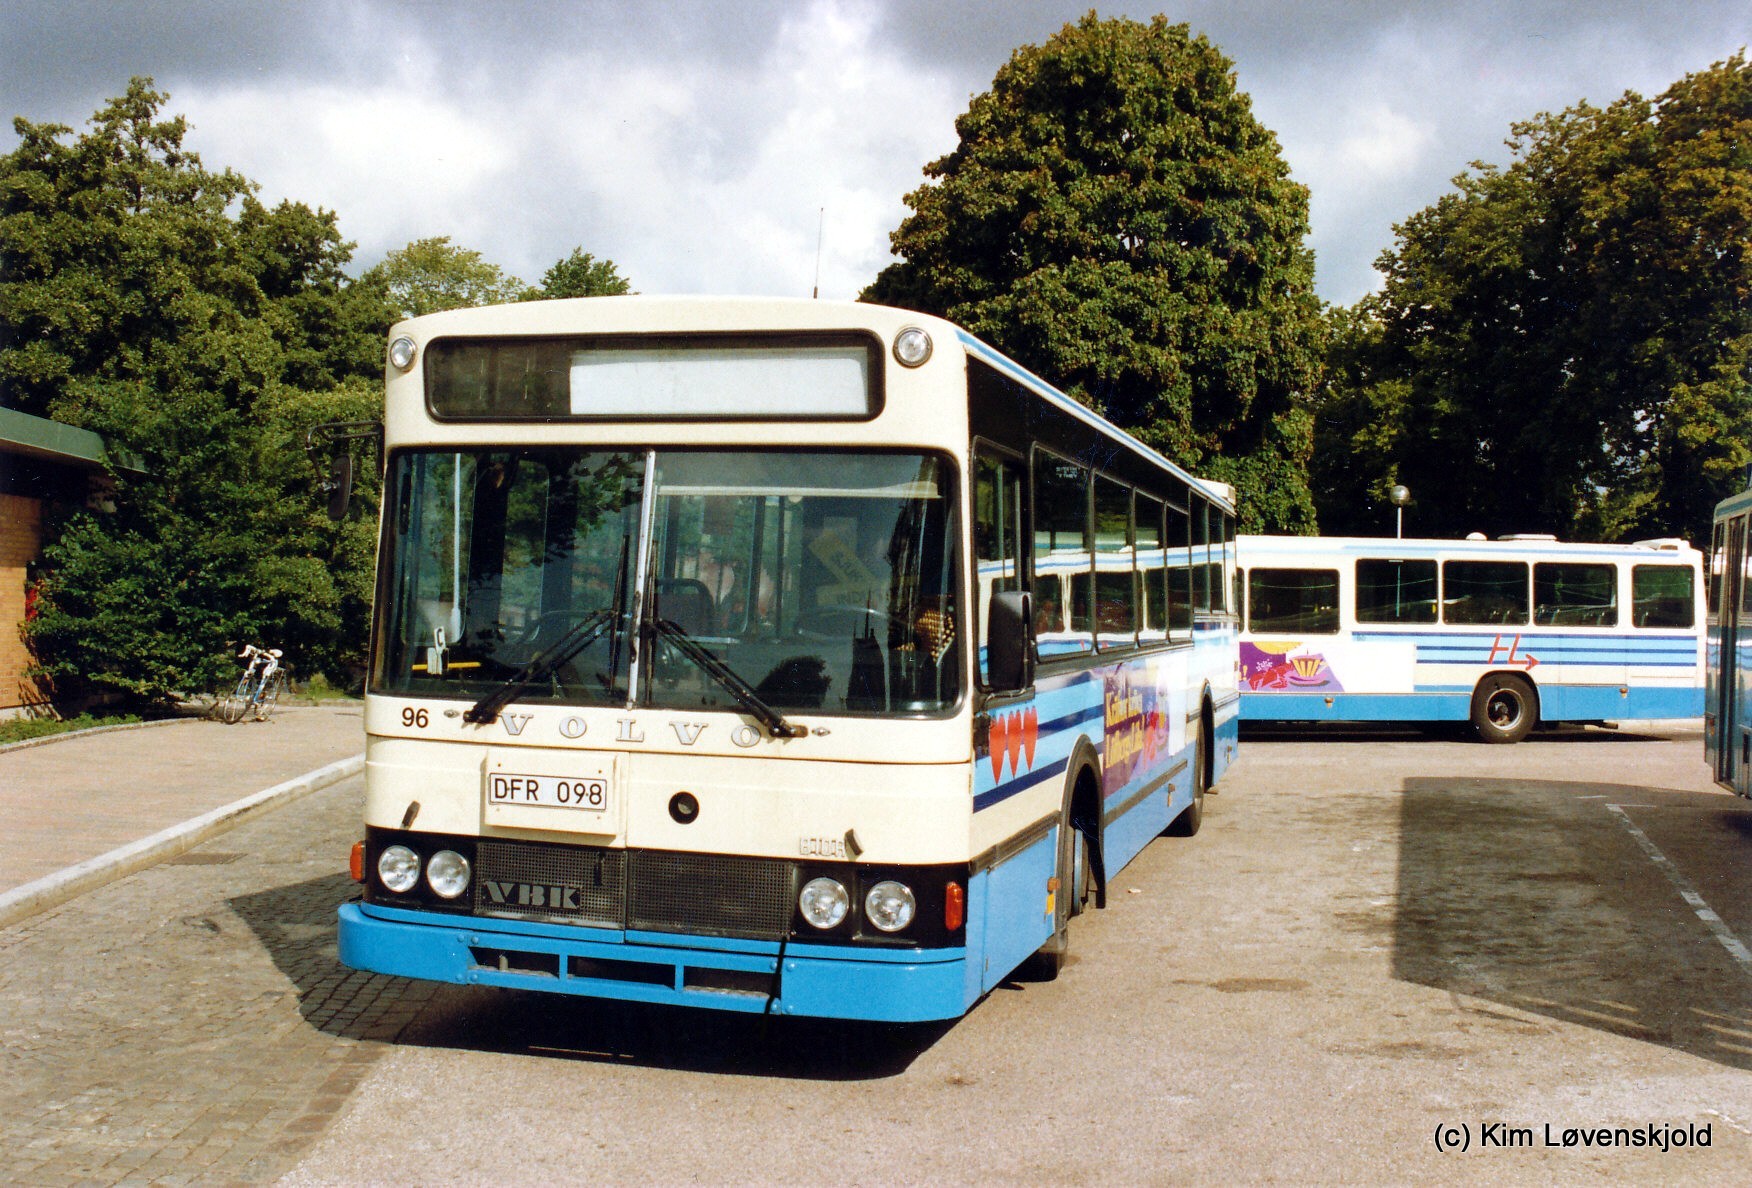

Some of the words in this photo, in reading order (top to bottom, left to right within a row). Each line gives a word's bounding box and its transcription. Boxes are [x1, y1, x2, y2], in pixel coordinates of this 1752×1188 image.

[401, 706, 429, 728] 96
[498, 711, 761, 748] VOLVO
[494, 777, 540, 801] DFR
[557, 781, 602, 805] 098
[484, 881, 578, 909] VBK
